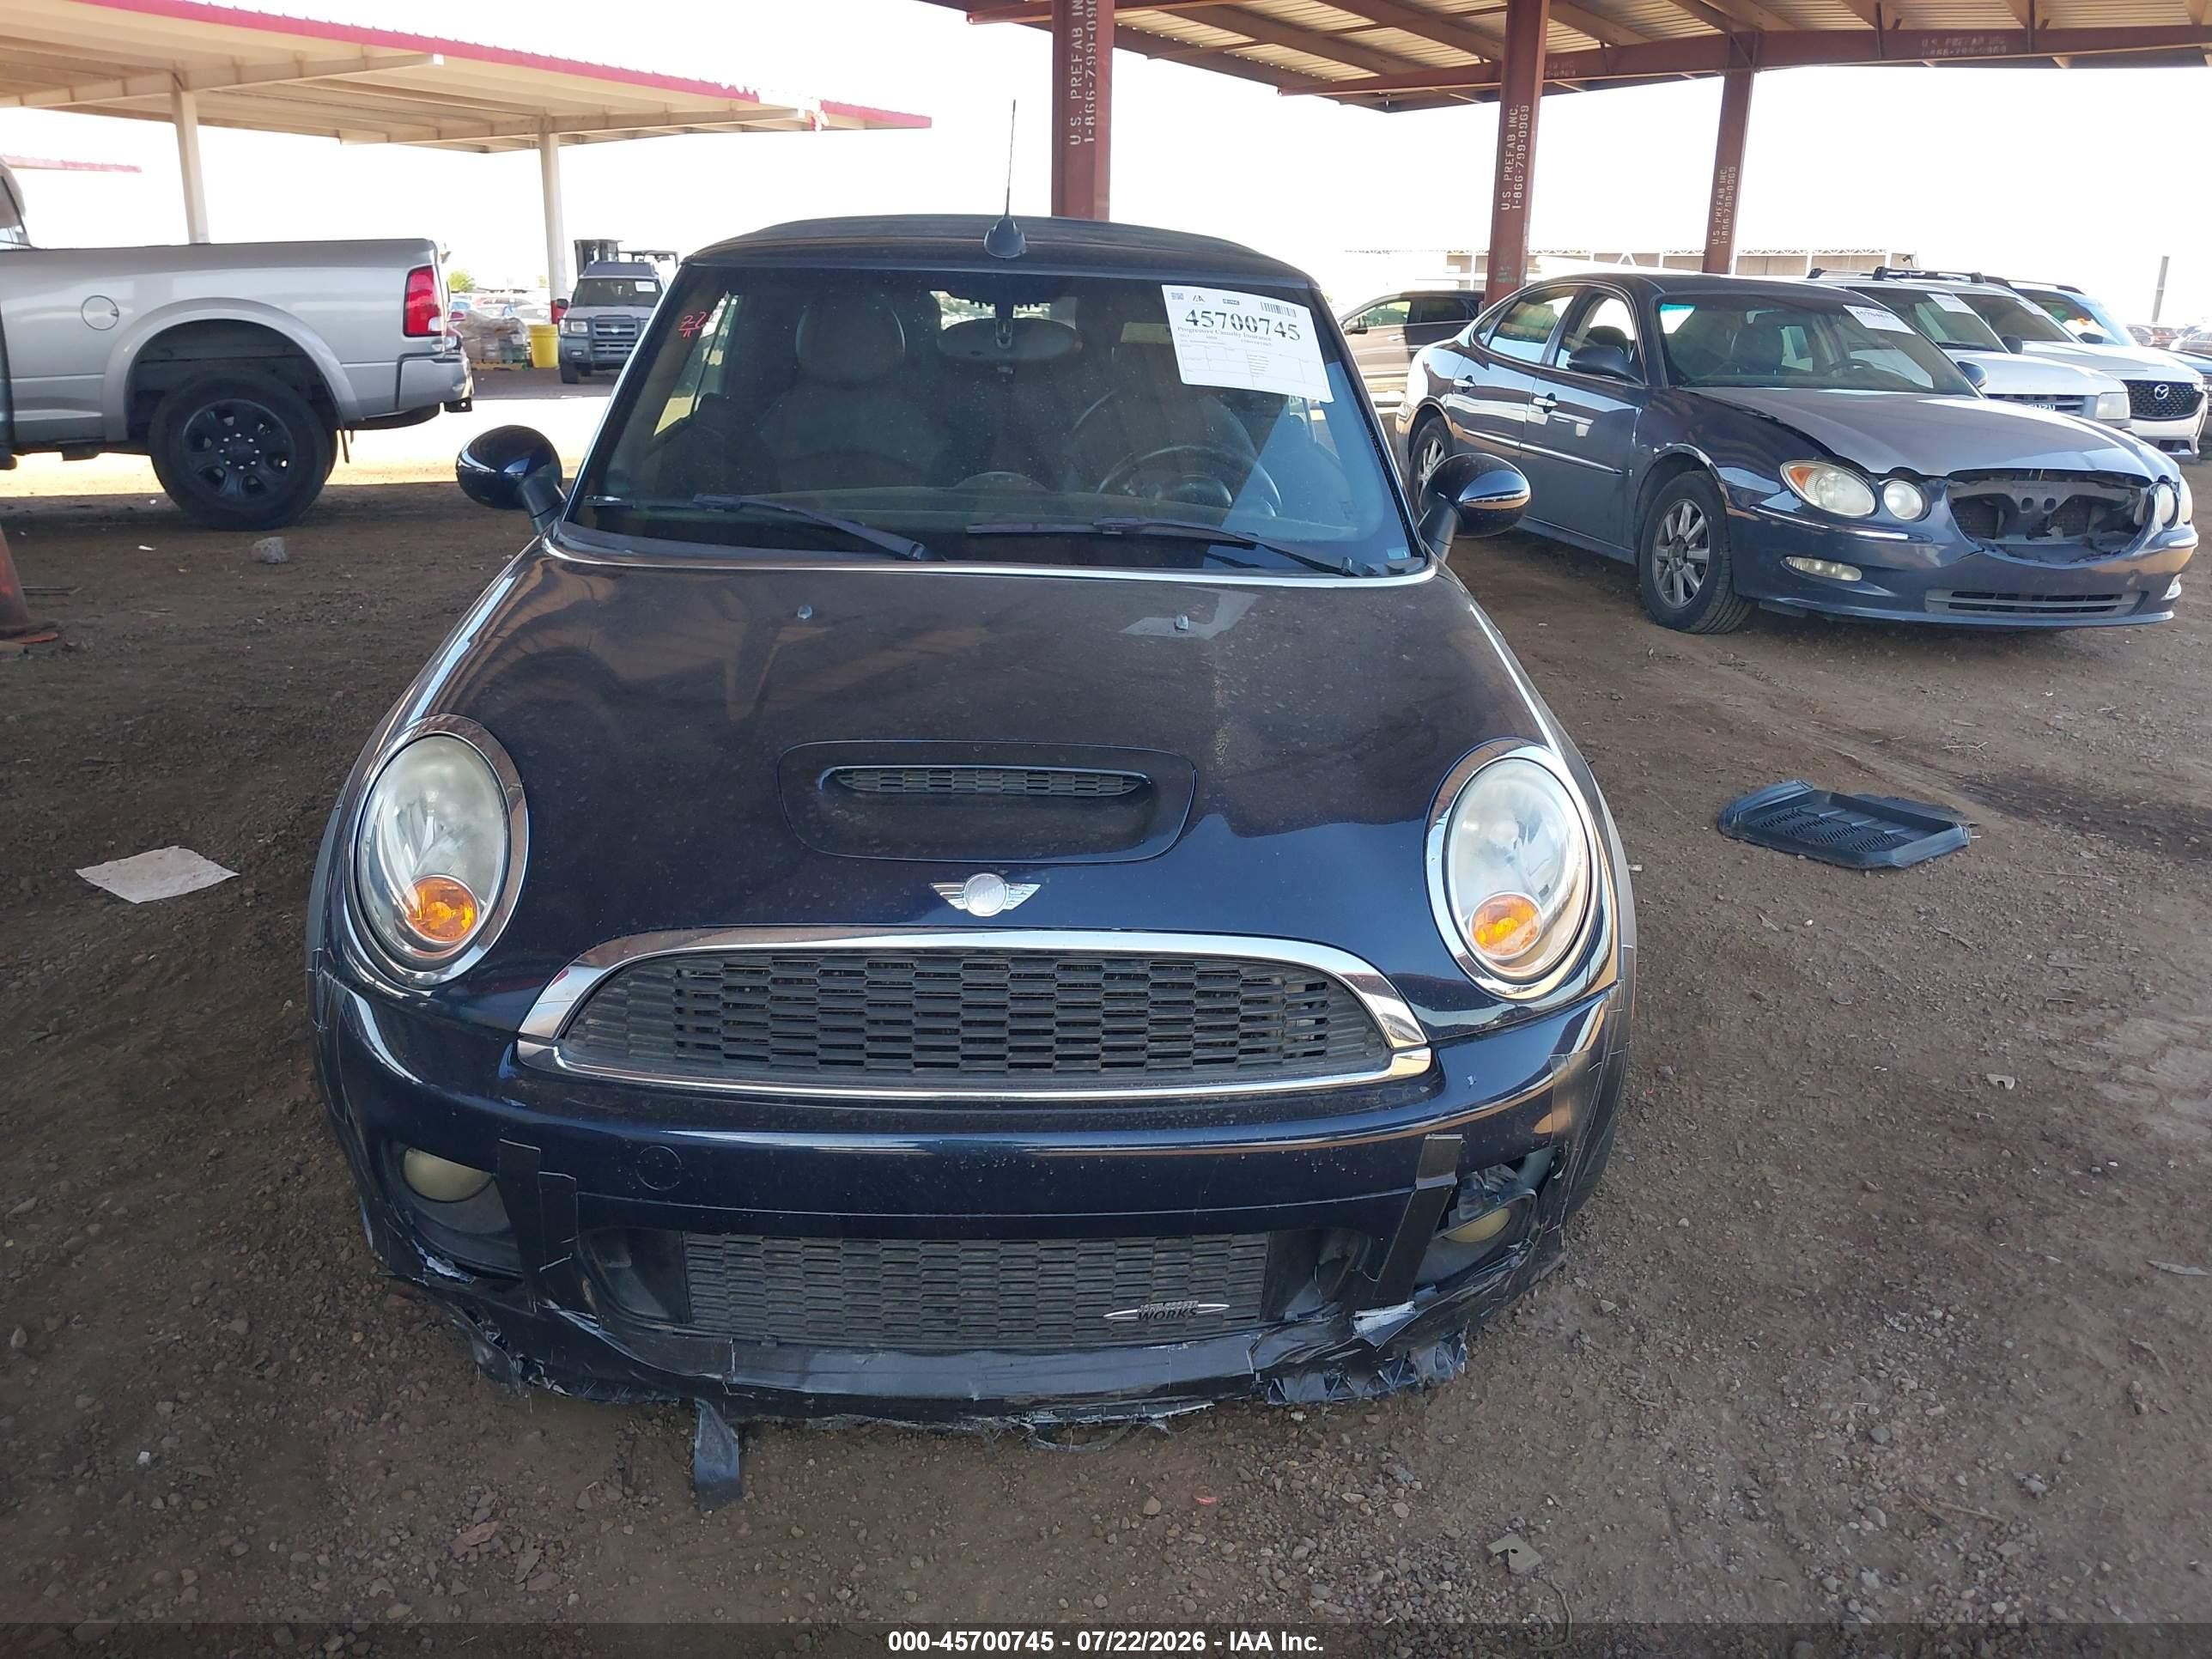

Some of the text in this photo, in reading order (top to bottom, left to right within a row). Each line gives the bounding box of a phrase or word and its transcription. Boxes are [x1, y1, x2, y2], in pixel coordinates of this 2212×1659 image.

[1071, 27, 1083, 99] PREFAB
[1070, 111, 1082, 145] U.S.
[1509, 104, 1519, 128] INC.
[1504, 133, 1516, 182] PREFAB
[1512, 104, 1530, 210] 1-866-799-0969
[1185, 308, 1301, 341] 45700745
[1138, 1308, 1198, 1321] WORKS
